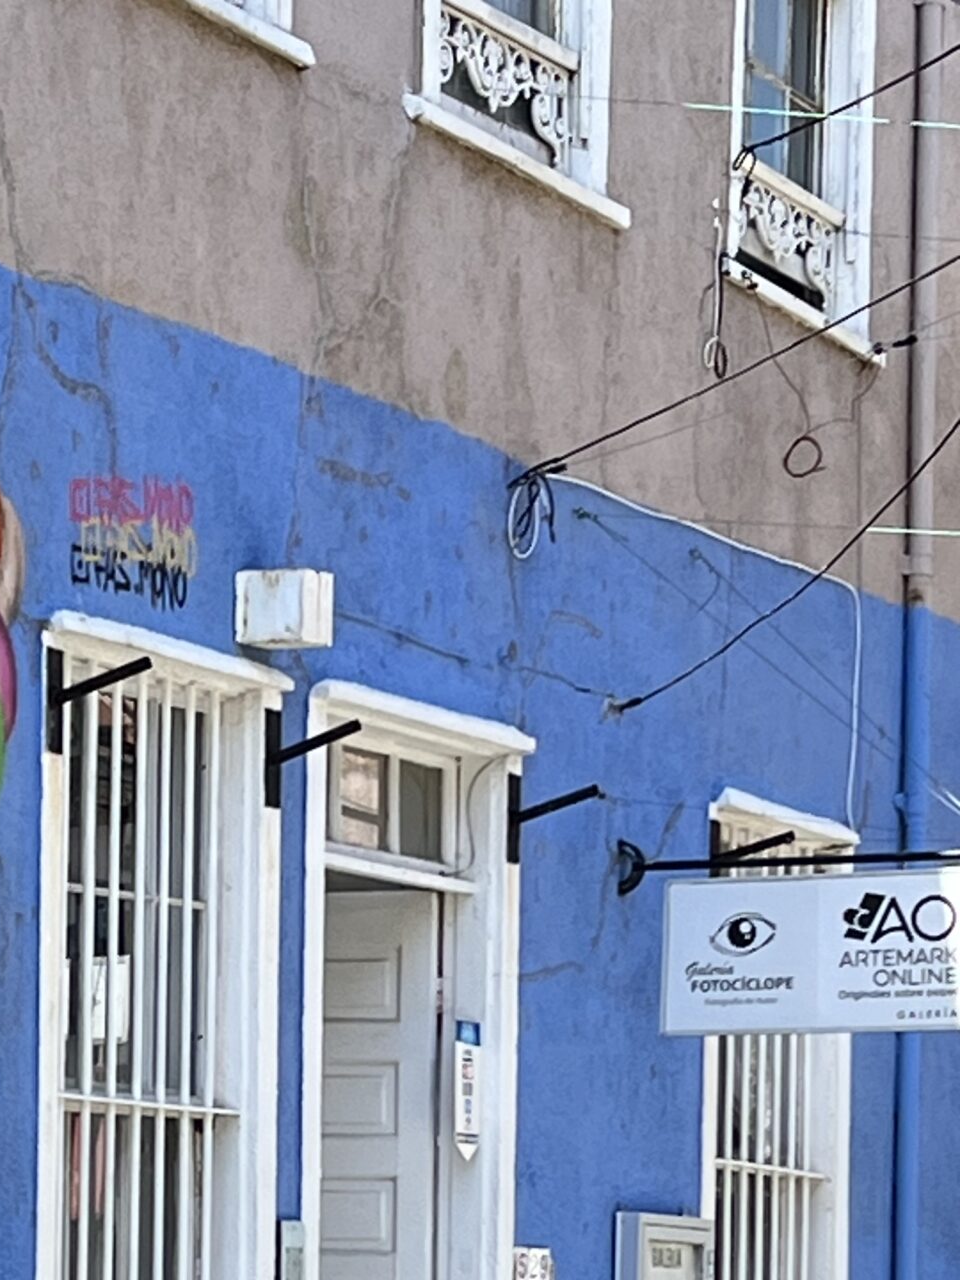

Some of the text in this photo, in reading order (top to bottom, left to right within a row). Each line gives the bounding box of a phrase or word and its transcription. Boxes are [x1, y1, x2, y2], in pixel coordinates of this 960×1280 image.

[838, 946, 958, 968] ARTEMARK
[691, 975, 795, 993] FOTOCÍCLOPE
[873, 967, 957, 987] ONLINE
